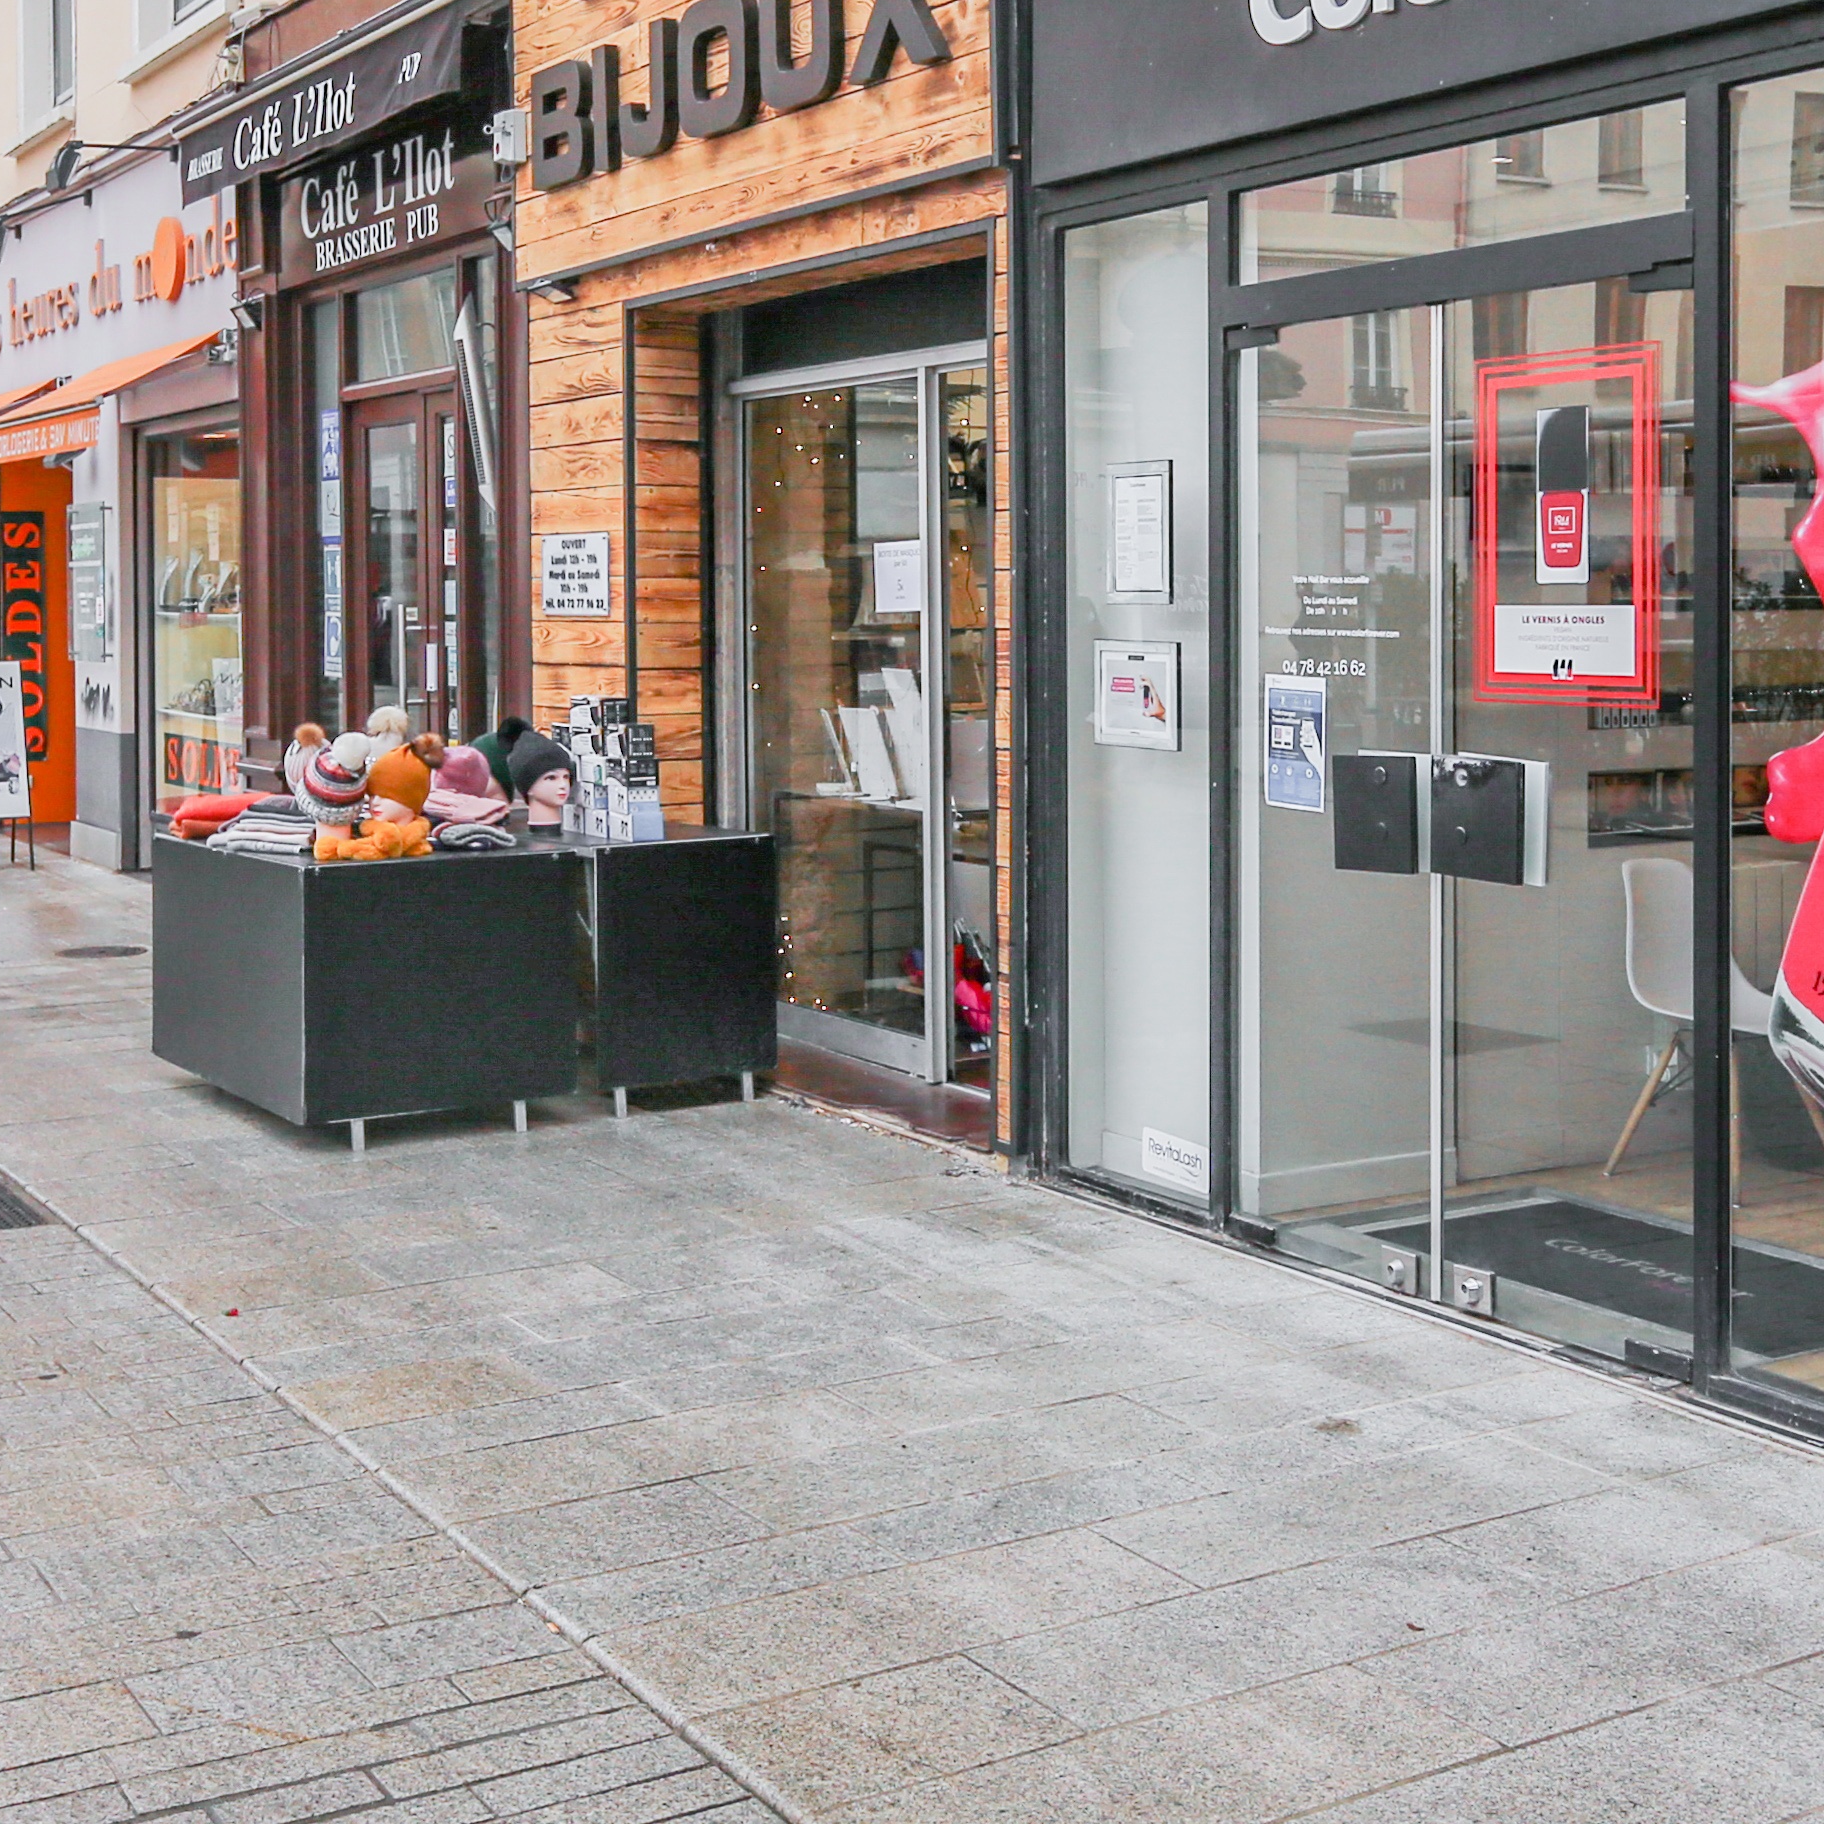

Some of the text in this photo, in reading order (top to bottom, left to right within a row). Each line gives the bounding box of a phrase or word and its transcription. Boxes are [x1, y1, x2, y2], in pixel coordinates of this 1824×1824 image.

[186, 146, 224, 182] BRASSERIE
[232, 100, 283, 170] Café
[397, 51, 422, 84] PUB
[300, 160, 359, 239] Café
[315, 203, 439, 272] BRASSERIE PUB
[8, 277, 79, 347] heures
[88, 238, 123, 318] du
[561, 538, 586, 549] OUVERT
[551, 554, 567, 565] Lundi
[549, 569, 566, 580] Mardi
[577, 568, 600, 579] Samedi
[557, 598, 565, 608] 04
[577, 598, 584, 608] 77
[1522, 613, 1605, 624] LE VERNIS À ONGLES
[1282, 658, 1366, 676] 04 78 42 16 62
[1148, 1137, 1203, 1171] RevitaLash
